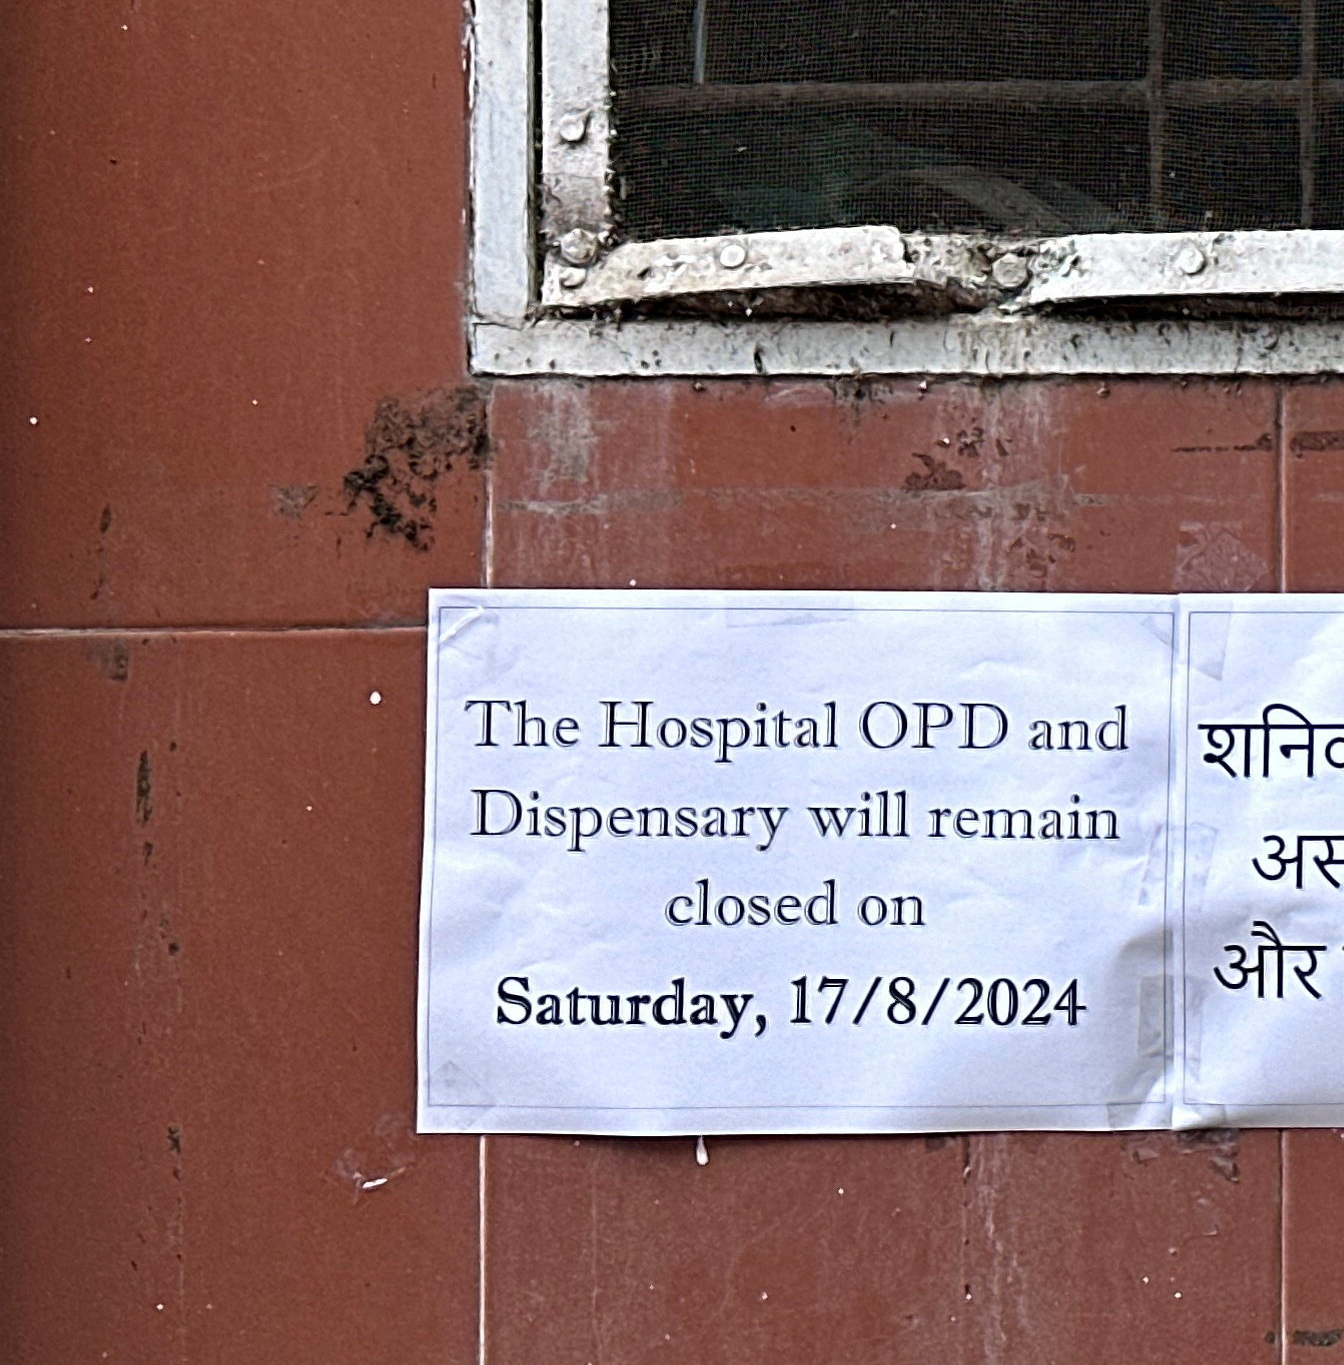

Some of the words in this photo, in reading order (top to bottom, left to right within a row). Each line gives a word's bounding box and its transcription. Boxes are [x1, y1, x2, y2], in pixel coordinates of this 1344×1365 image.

[464, 700, 579, 747] The
[598, 701, 838, 763] Hospital
[859, 702, 1008, 749] OPD
[1031, 705, 1129, 751] and
[470, 790, 789, 852] Dispensary
[807, 790, 910, 837] will
[928, 794, 1120, 839] remain
[665, 878, 838, 926] closed
[861, 896, 925, 925] on
[1213, 921, 1327, 999] और
[497, 977, 766, 1039] Saturday,
[790, 975, 1087, 1026] 17/8/2024
